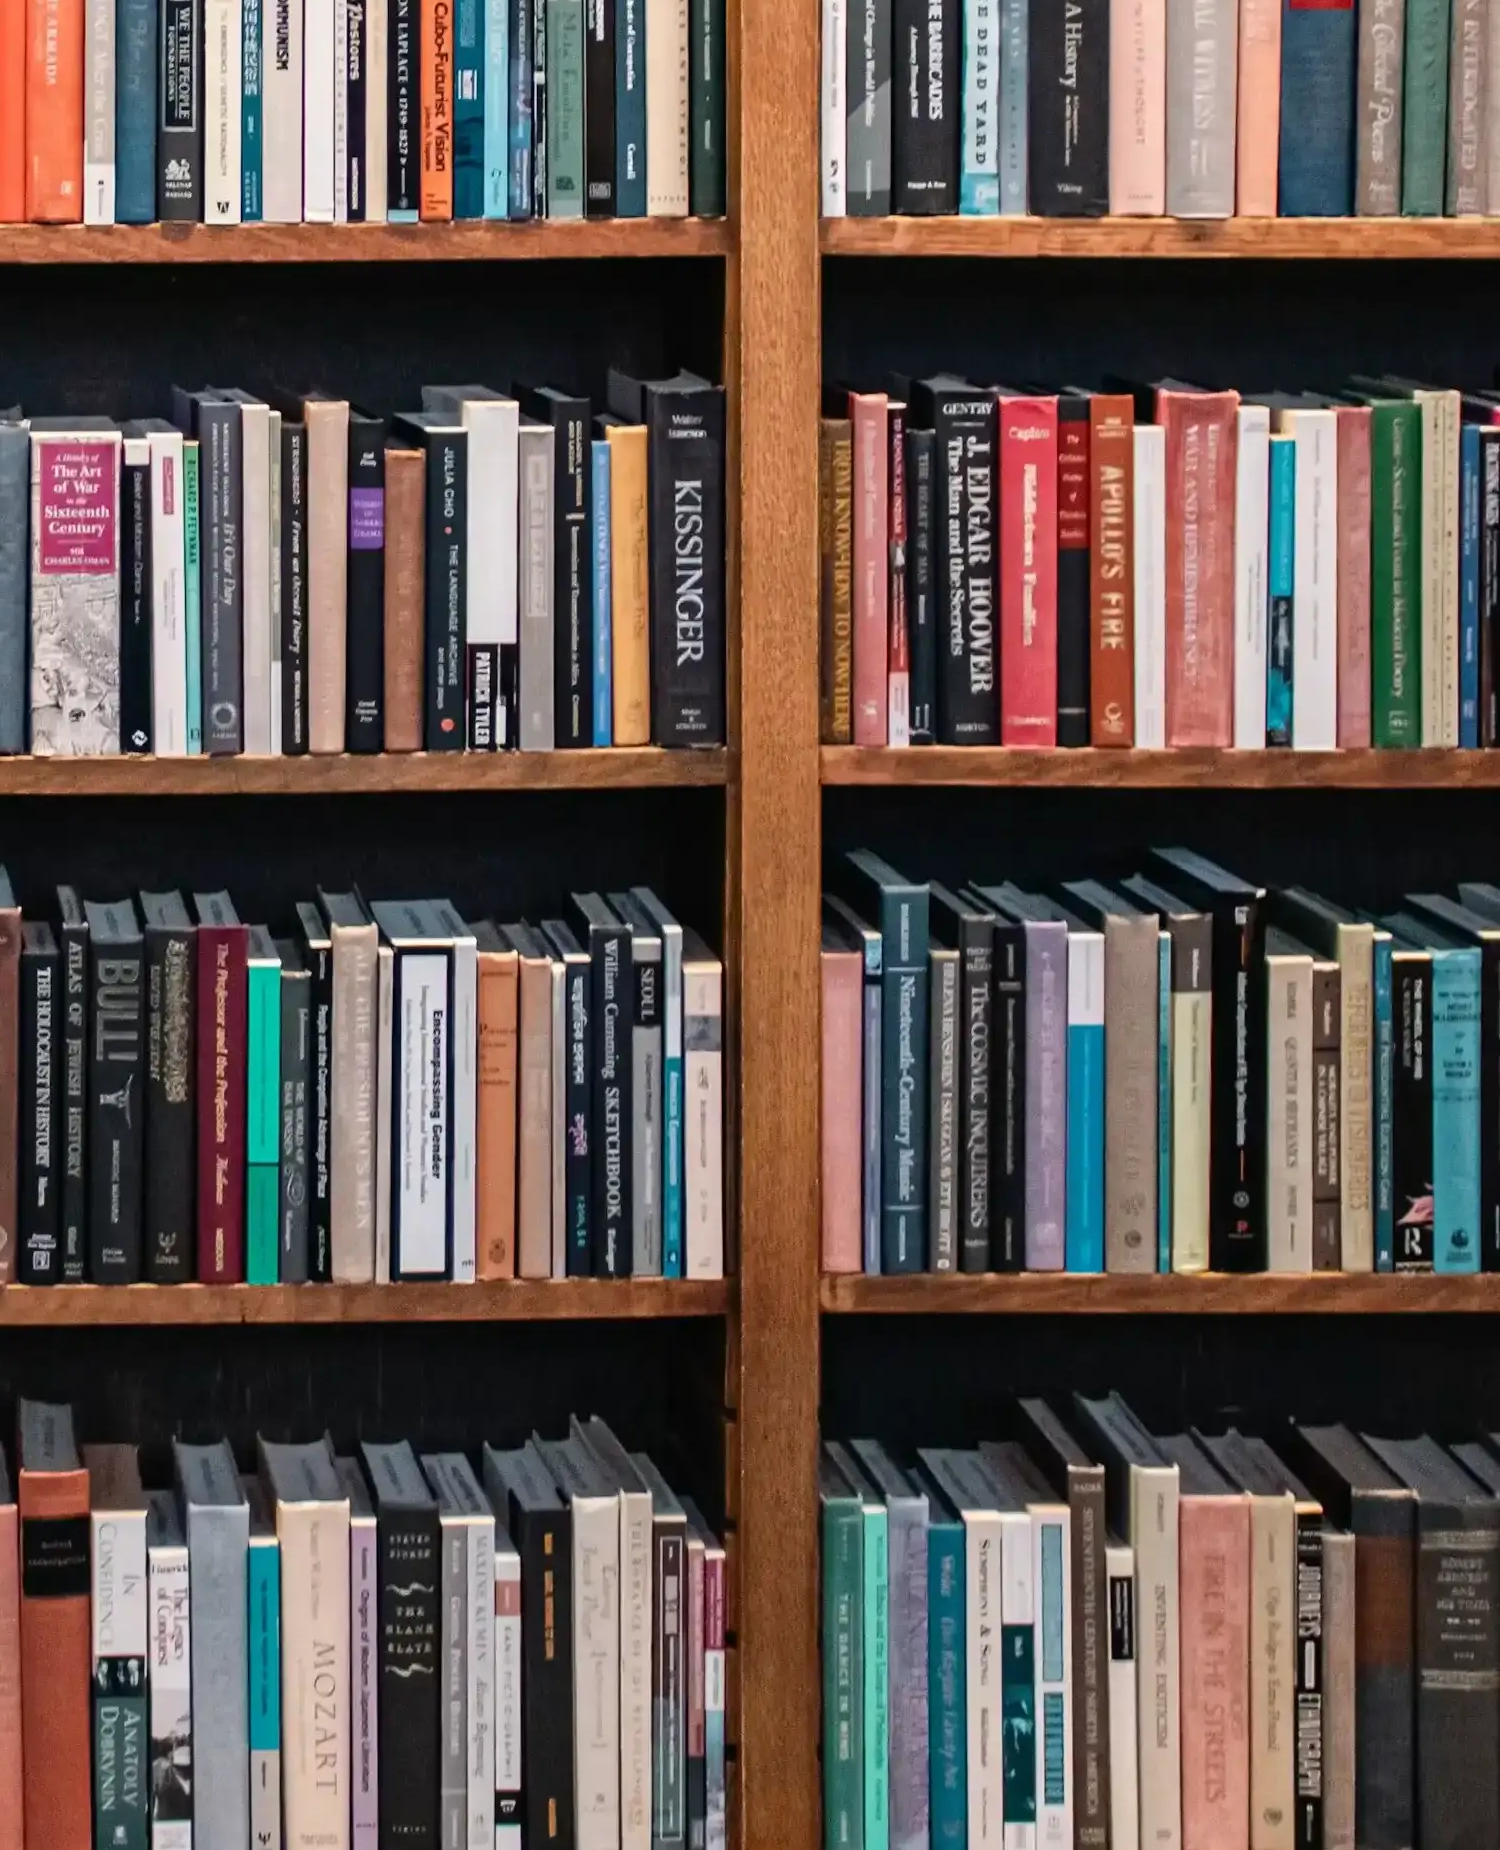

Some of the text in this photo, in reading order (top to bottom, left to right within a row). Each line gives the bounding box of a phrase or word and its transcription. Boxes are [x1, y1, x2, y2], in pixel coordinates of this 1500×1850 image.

[397, 23, 409, 83] LAPLACE
[434, 2, 447, 116] Cubo-Futurist
[976, 29, 988, 90] DEAD
[1060, 23, 1082, 88] History
[1066, 3, 1082, 19] A
[179, 7, 190, 119] WE THE PEOPLE
[928, 21, 942, 119] BARRICADES
[435, 122, 448, 172] Vision
[975, 100, 988, 165] YARD
[45, 505, 110, 518] Sixteenth
[52, 465, 102, 478] The Art
[54, 480, 100, 494] of War
[444, 448, 455, 518] JULIA CHO
[48, 523, 106, 537] Century
[675, 480, 704, 666] KISSINGER
[948, 436, 964, 656] The Man and the Secrets
[967, 436, 993, 694] J. EDGAR HOOVER
[1101, 466, 1124, 650] APOLLO'S FIRE
[448, 544, 458, 686] THE LANGUAGE ARCHIVE
[476, 652, 490, 744] PATRICK TYLER
[96, 960, 139, 1061] BULL!
[640, 967, 654, 1020] SEOUL
[68, 941, 82, 1177] ATLAS OF JEWISH HISTORY
[430, 1010, 443, 1179] Encompassing Gender
[602, 939, 620, 1219] William Cumming SKETCHBOOK
[894, 975, 915, 1201] Nineteenth-Century Music
[969, 983, 988, 1228] The COSMIC INQUIRERS
[313, 1641, 337, 1795] MOZART
[1298, 1563, 1320, 1797] JOURNEYS ETHNOGRAPHY
